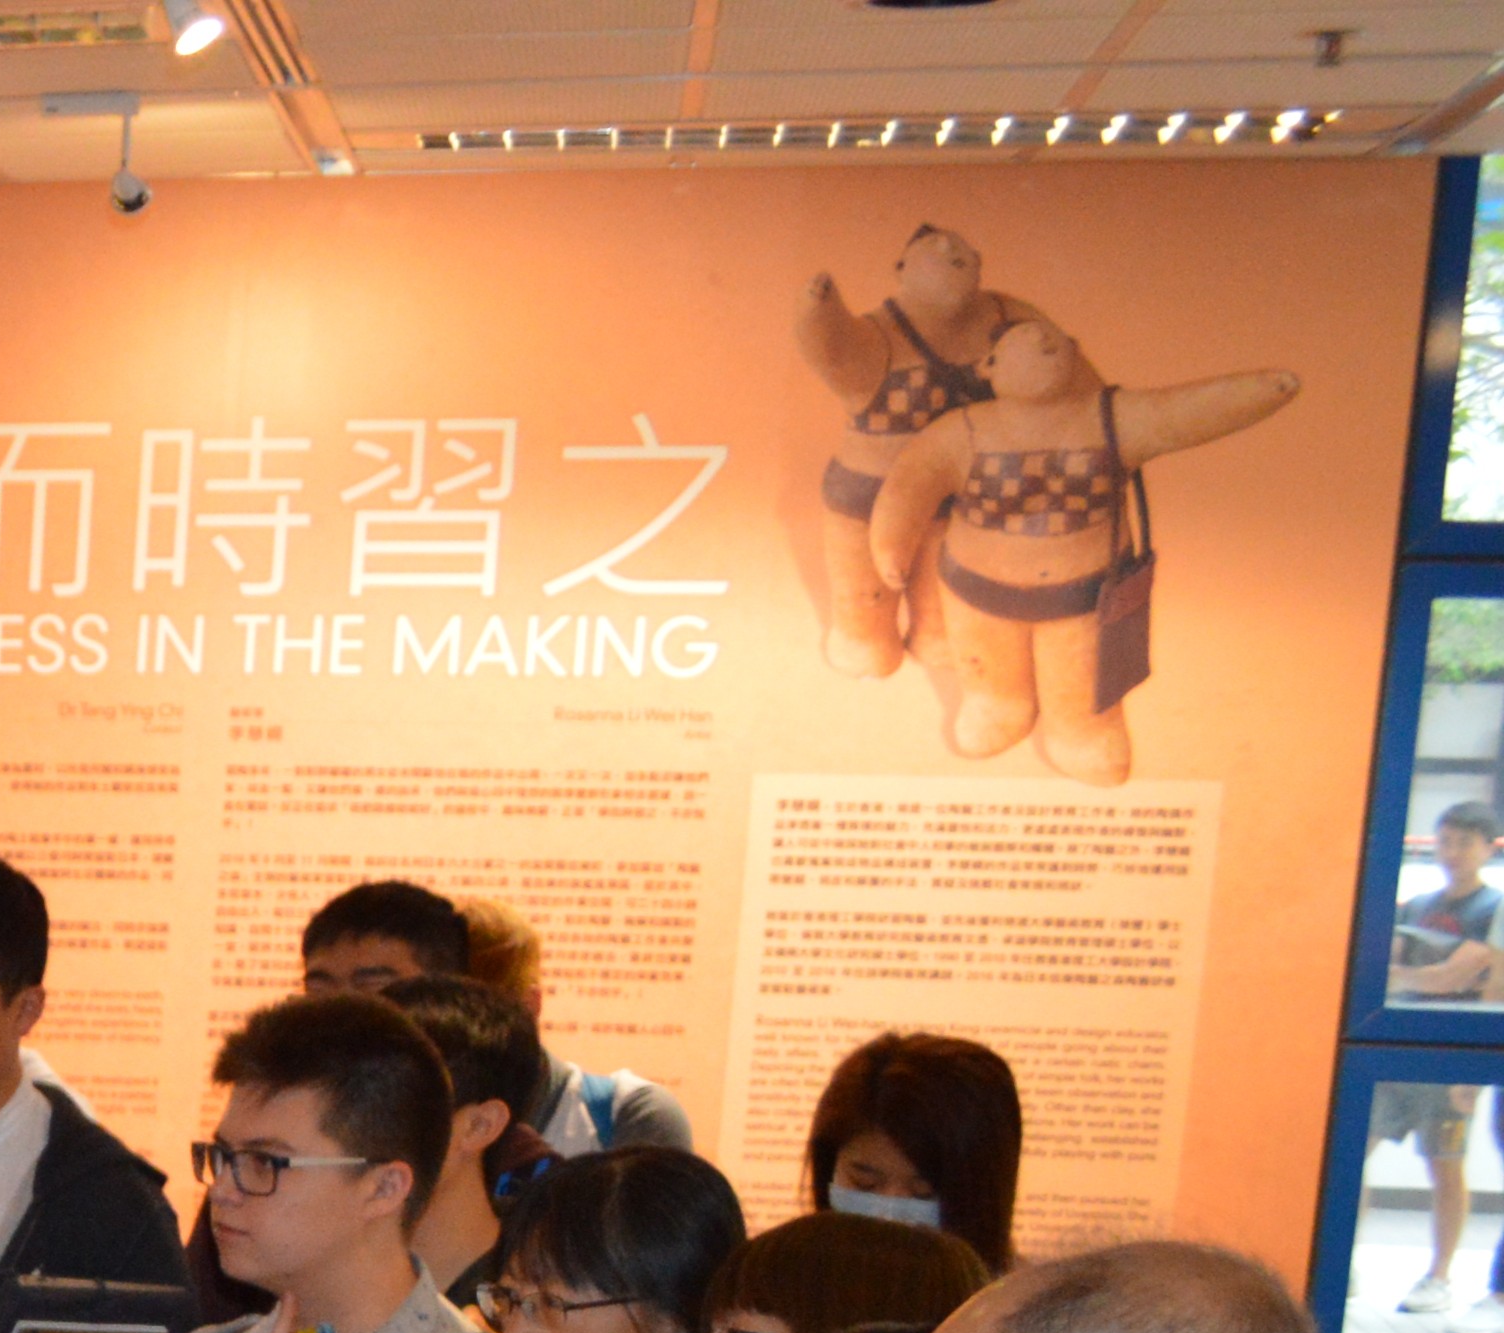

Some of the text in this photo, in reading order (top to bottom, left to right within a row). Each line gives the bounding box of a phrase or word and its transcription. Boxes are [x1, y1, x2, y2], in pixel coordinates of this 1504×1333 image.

[135, 614, 205, 674] IN
[232, 614, 365, 675] THE
[392, 614, 720, 678] MAKING
